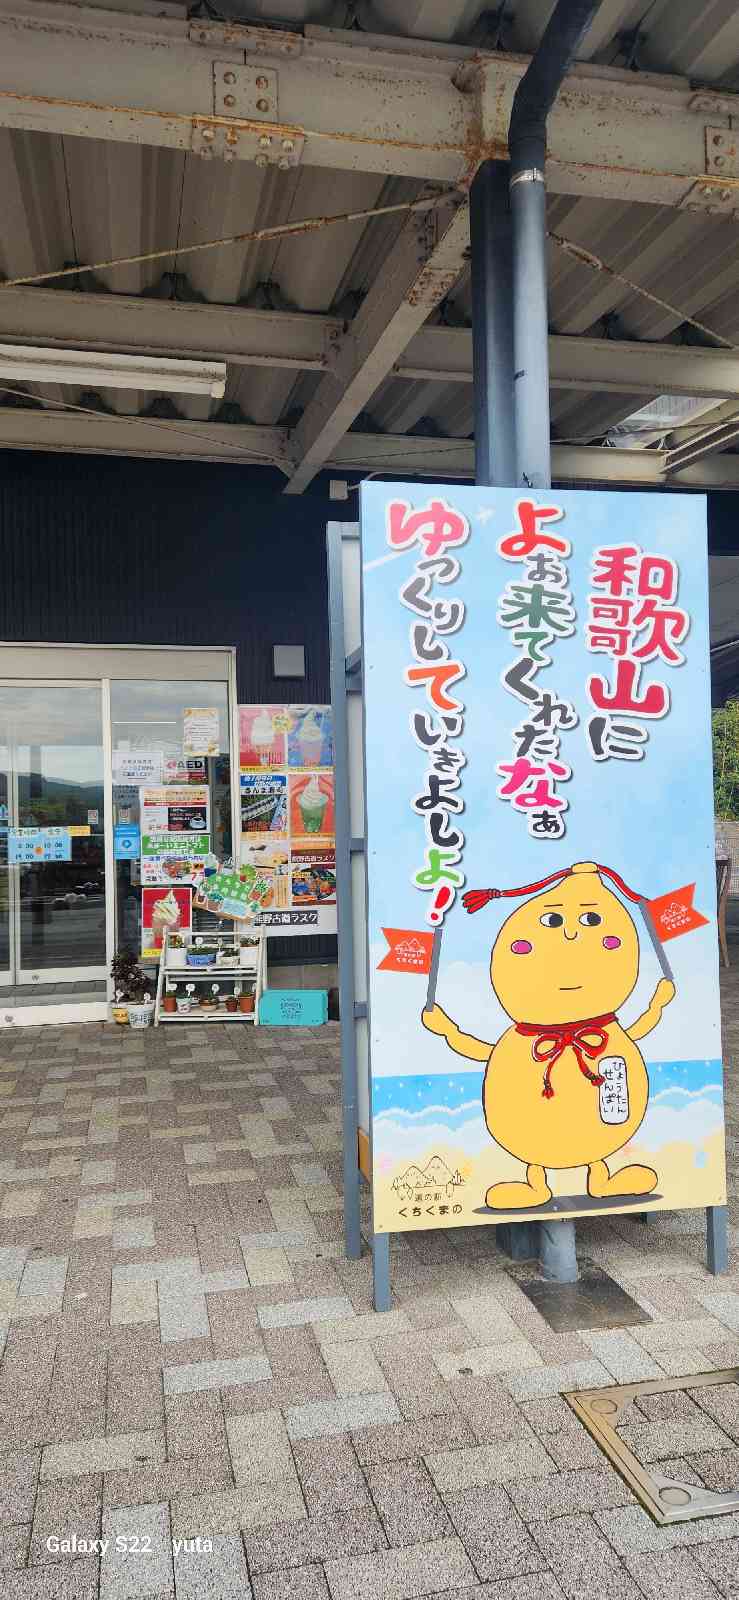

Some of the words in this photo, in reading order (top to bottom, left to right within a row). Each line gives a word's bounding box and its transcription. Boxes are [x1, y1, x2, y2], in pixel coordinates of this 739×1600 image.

[588, 546, 686, 757] 和歌山に
[177, 760, 203, 769] AED
[398, 1204, 463, 1218] くちくまの
